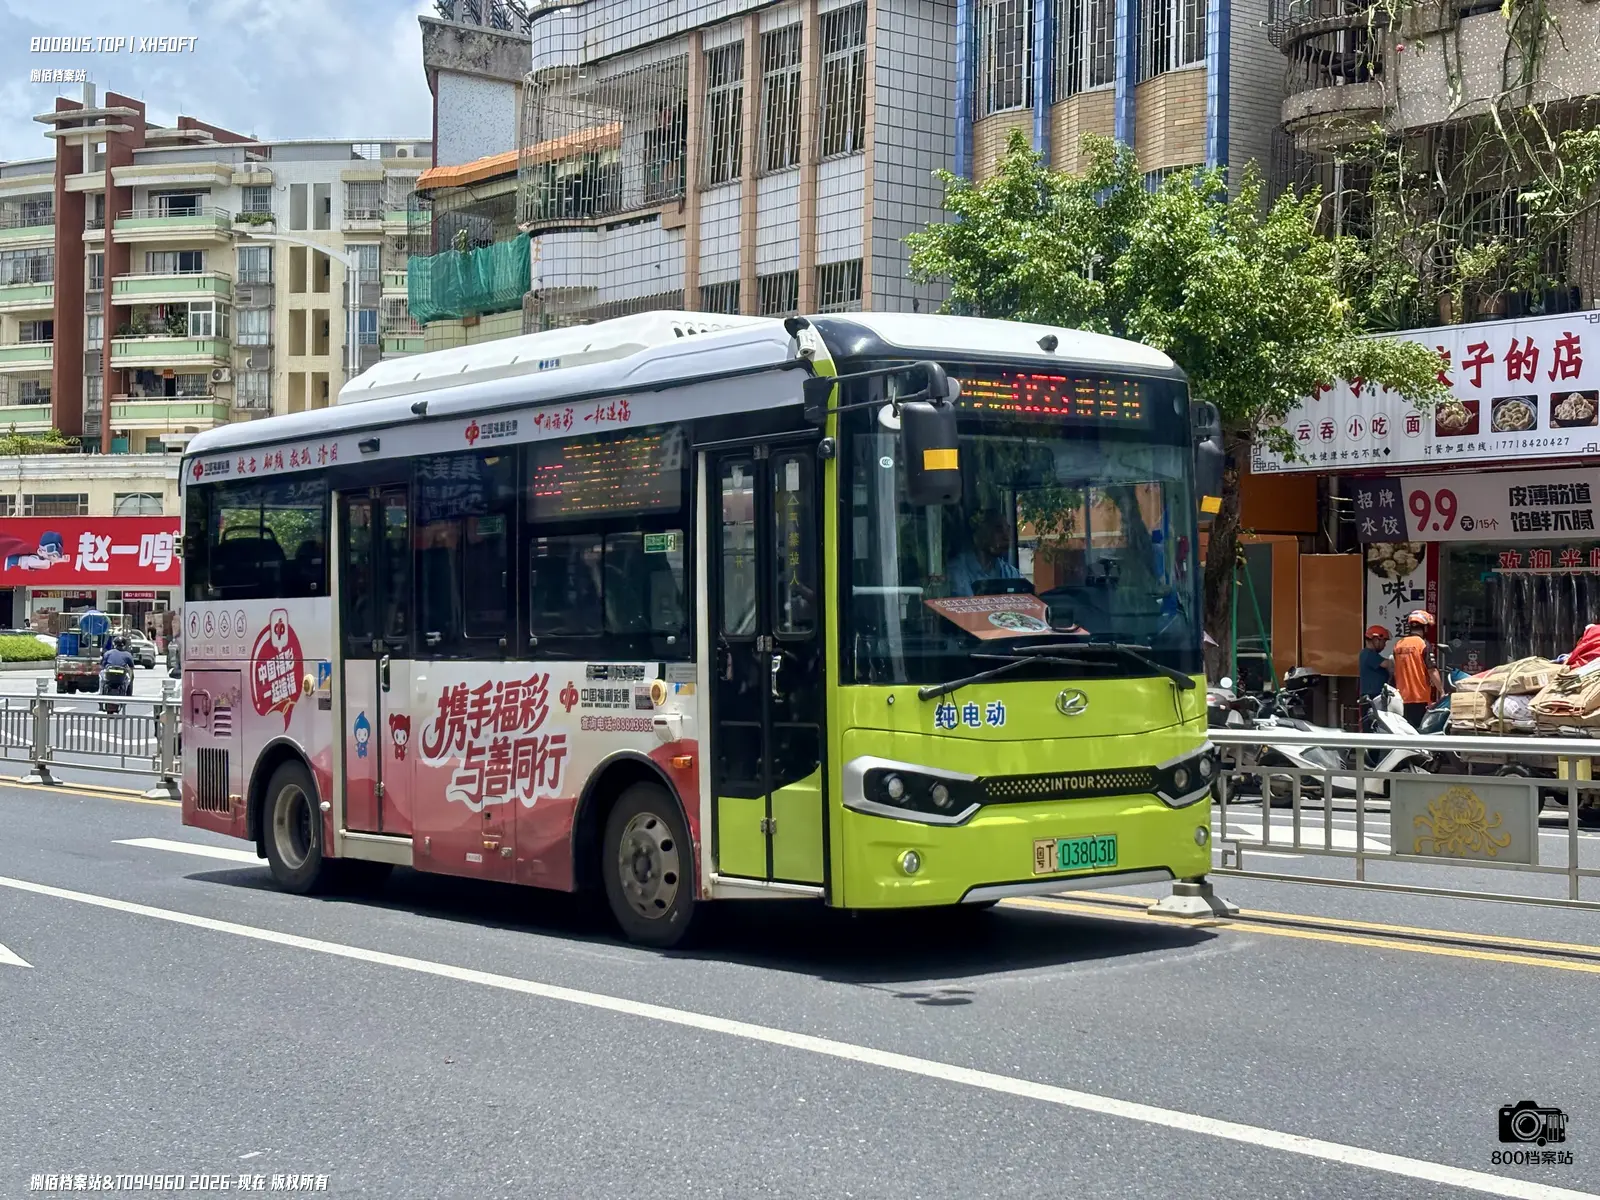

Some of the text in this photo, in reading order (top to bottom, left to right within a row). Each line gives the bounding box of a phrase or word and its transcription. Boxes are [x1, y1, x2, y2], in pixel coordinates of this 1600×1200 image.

[1297, 416, 1421, 441] 云吞 小吃 面
[1357, 488, 1395, 509] 招牌
[1508, 483, 1592, 507] 皮薄筋道
[1408, 488, 1458, 532] 9.9
[1510, 509, 1595, 532] 馅鲜不腻
[1361, 515, 1400, 536] 水饺
[75, 531, 174, 572] 赵一鸣
[581, 688, 630, 703] 中国福利彩票
[422, 672, 550, 761] 携手福彩
[935, 700, 1006, 728] 纯电动
[450, 734, 567, 804] 与善同行
[1050, 776, 1095, 790] INTOUR
